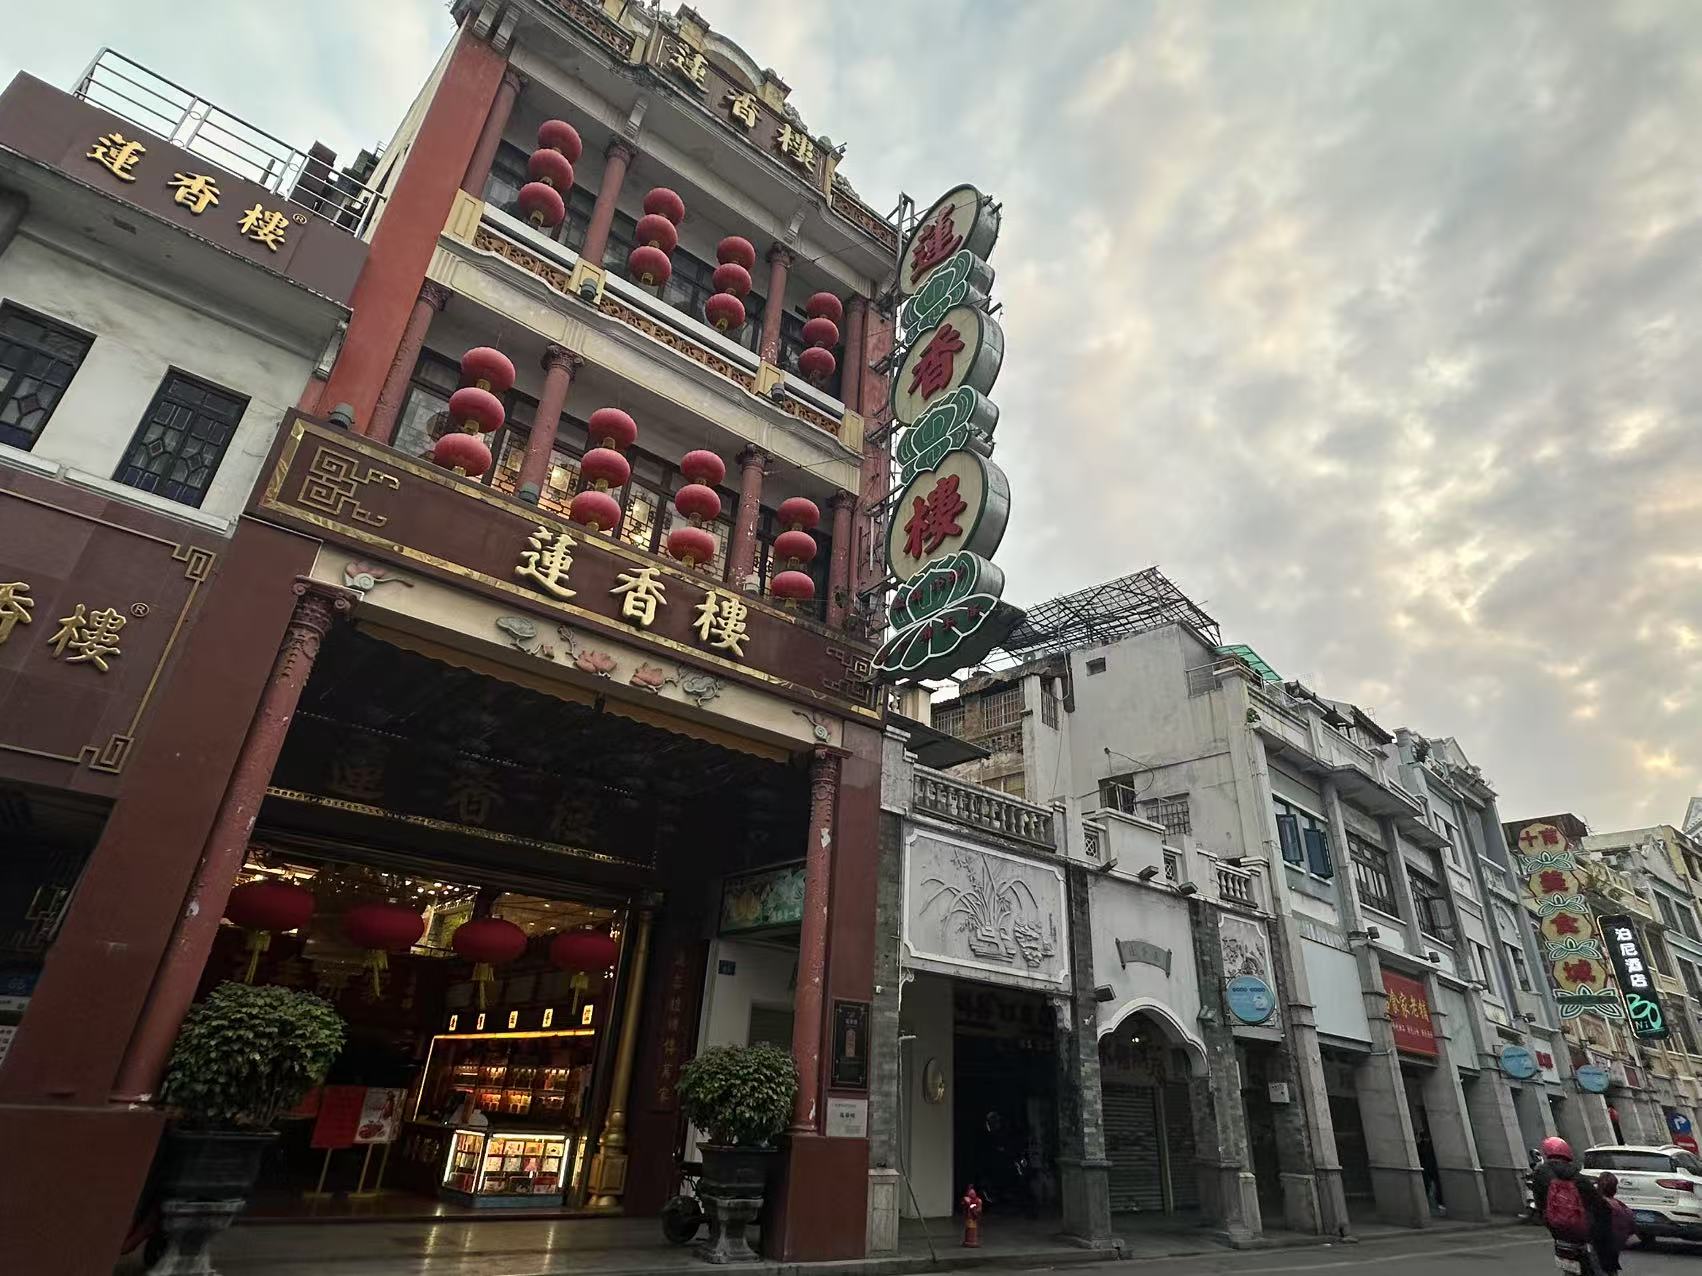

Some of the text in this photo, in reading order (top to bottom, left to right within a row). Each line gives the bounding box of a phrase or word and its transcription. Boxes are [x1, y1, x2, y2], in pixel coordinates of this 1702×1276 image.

[665, 43, 816, 173] 蓮香樓
[86, 132, 289, 252] 蓮香樓
[903, 202, 967, 560] 蓮香樓
[514, 525, 751, 658] 蓮香樓
[1615, 927, 1648, 988] 泊尼酒店
